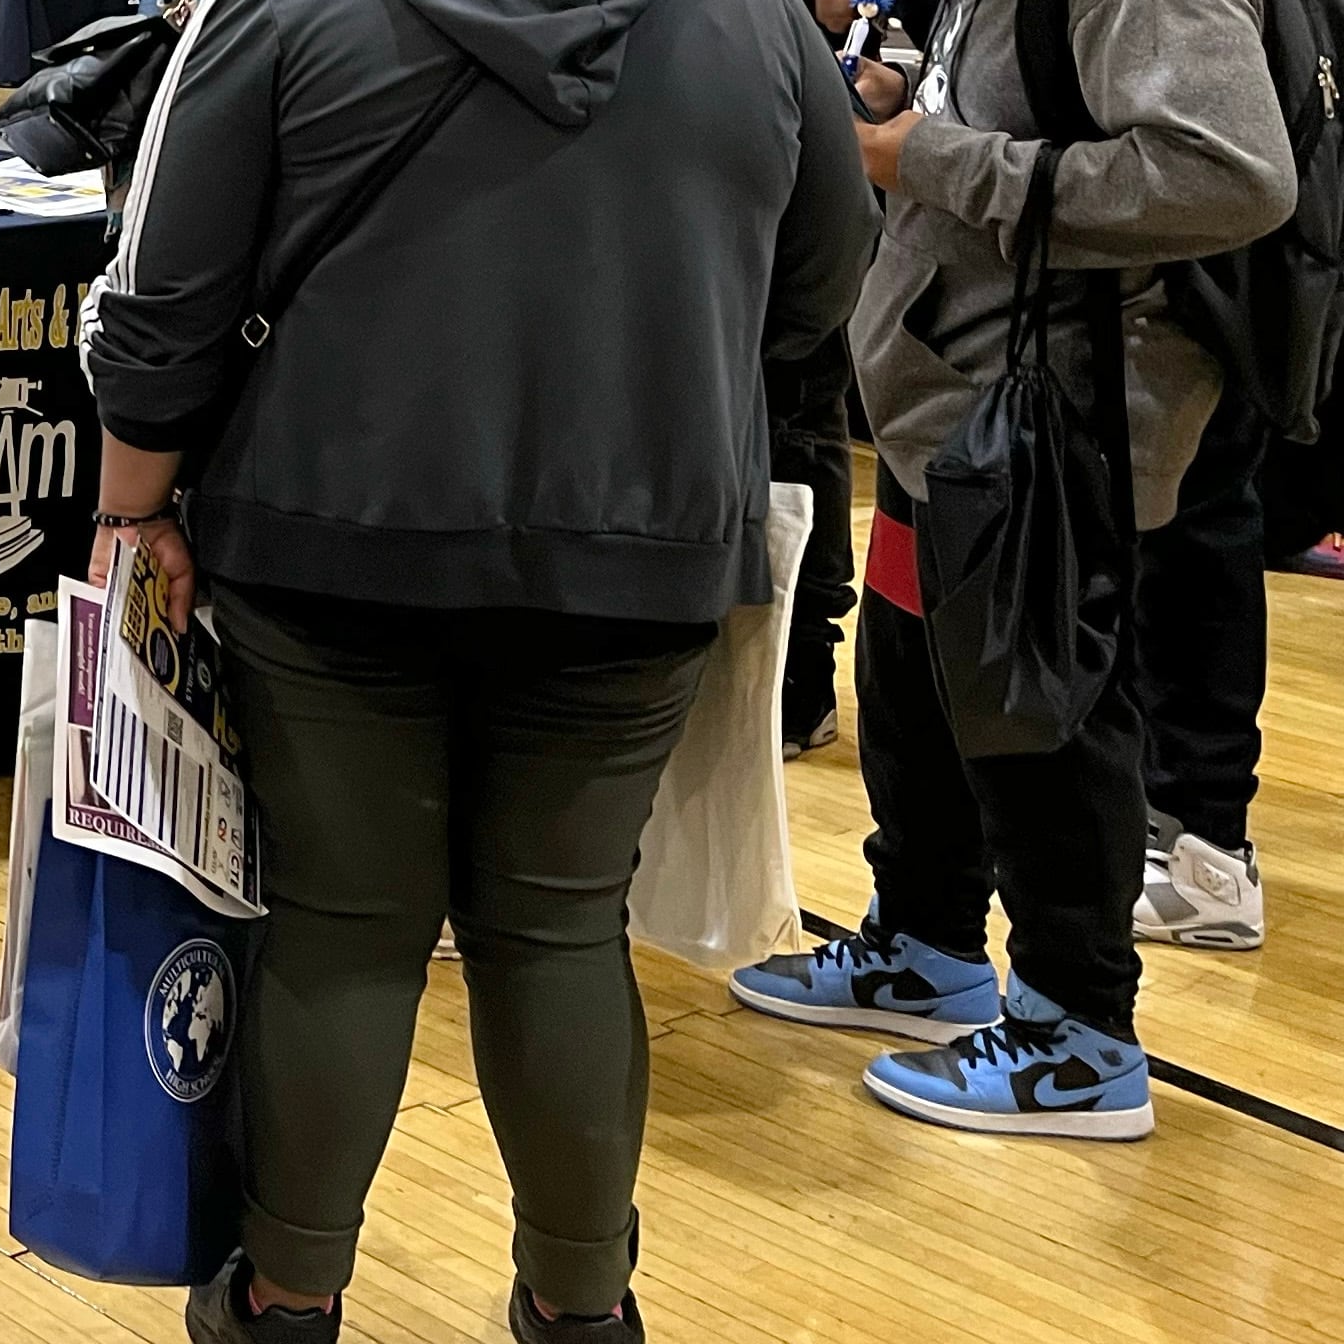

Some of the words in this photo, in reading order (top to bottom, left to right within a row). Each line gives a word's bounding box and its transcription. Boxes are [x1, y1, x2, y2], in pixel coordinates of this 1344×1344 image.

[48, 284, 69, 348] &
[69, 808, 172, 856] REQUIRE
[158, 950, 226, 998] MULTICULTU
